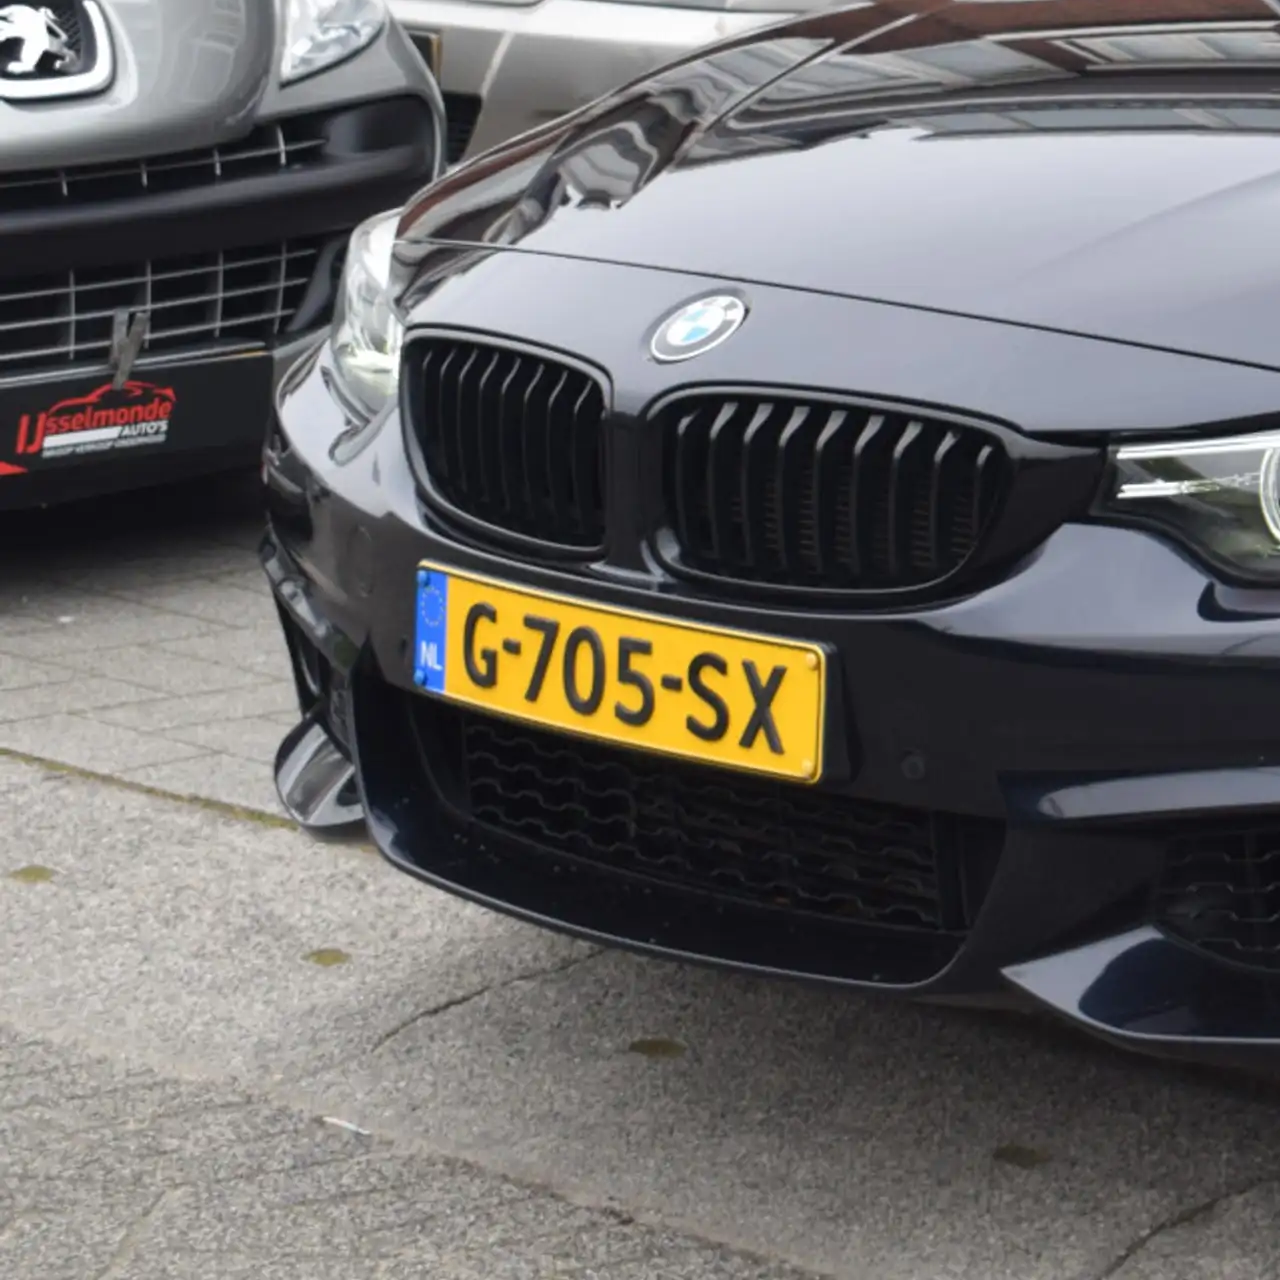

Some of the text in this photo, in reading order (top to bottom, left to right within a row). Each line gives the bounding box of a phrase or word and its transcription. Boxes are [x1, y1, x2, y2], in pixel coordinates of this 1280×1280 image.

[16, 399, 172, 454] IJsselmonde
[120, 419, 168, 436] AUTO'S
[420, 640, 443, 672] NL
[462, 601, 788, 756] G-705-SX
